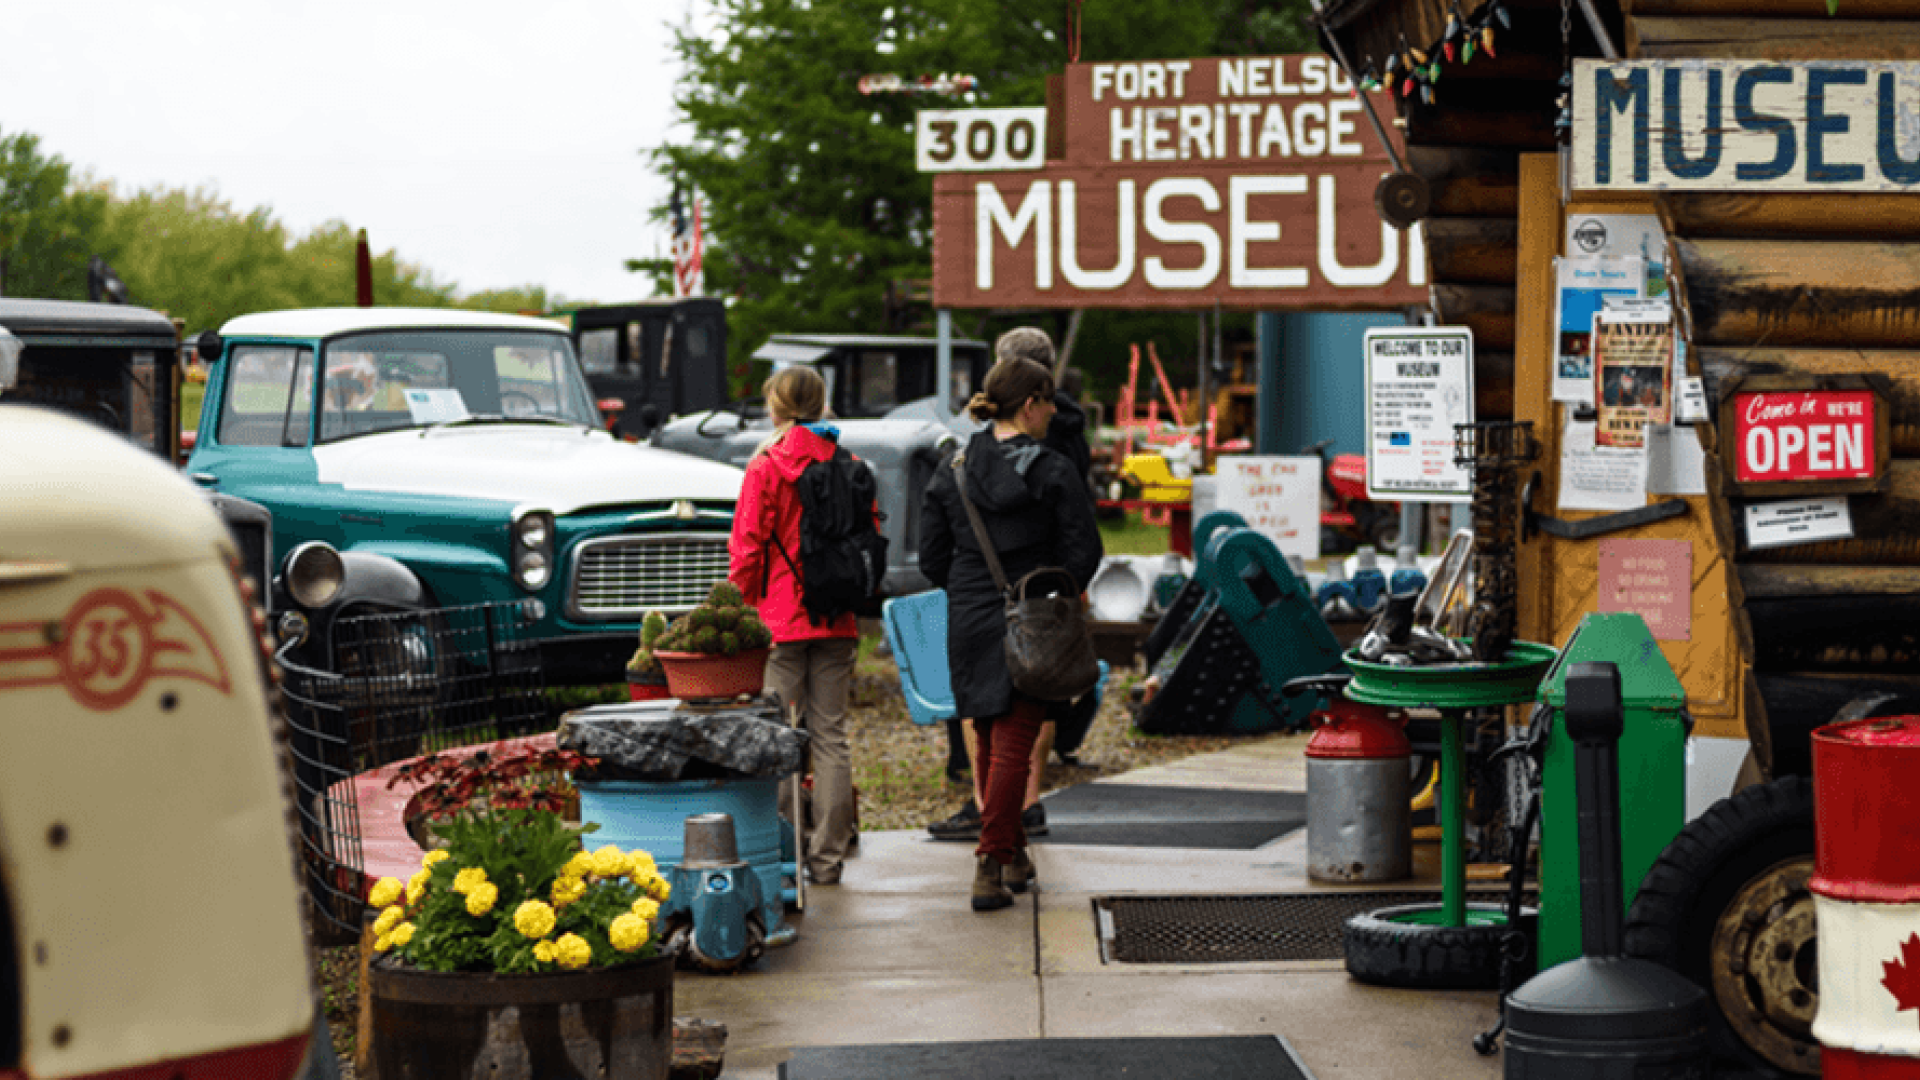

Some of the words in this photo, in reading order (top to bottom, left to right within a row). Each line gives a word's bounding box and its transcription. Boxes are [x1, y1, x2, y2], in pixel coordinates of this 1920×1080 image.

[1092, 61, 1192, 100] FORT
[1218, 55, 1382, 96] NELSO
[926, 118, 1036, 163] 300
[1110, 99, 1364, 162] HERITAGE
[975, 174, 1427, 290] MUSEU
[1374, 340, 1422, 356] WELCOME
[1425, 340, 1438, 356] TO
[1441, 340, 1463, 356] OUR
[1396, 361, 1441, 377] MUSEUM
[1746, 394, 1796, 424] Come
[1799, 392, 1817, 415] in
[1827, 401, 1864, 417] WE'RE
[1745, 423, 1865, 473] OPEN
[76, 617, 133, 679] 35
